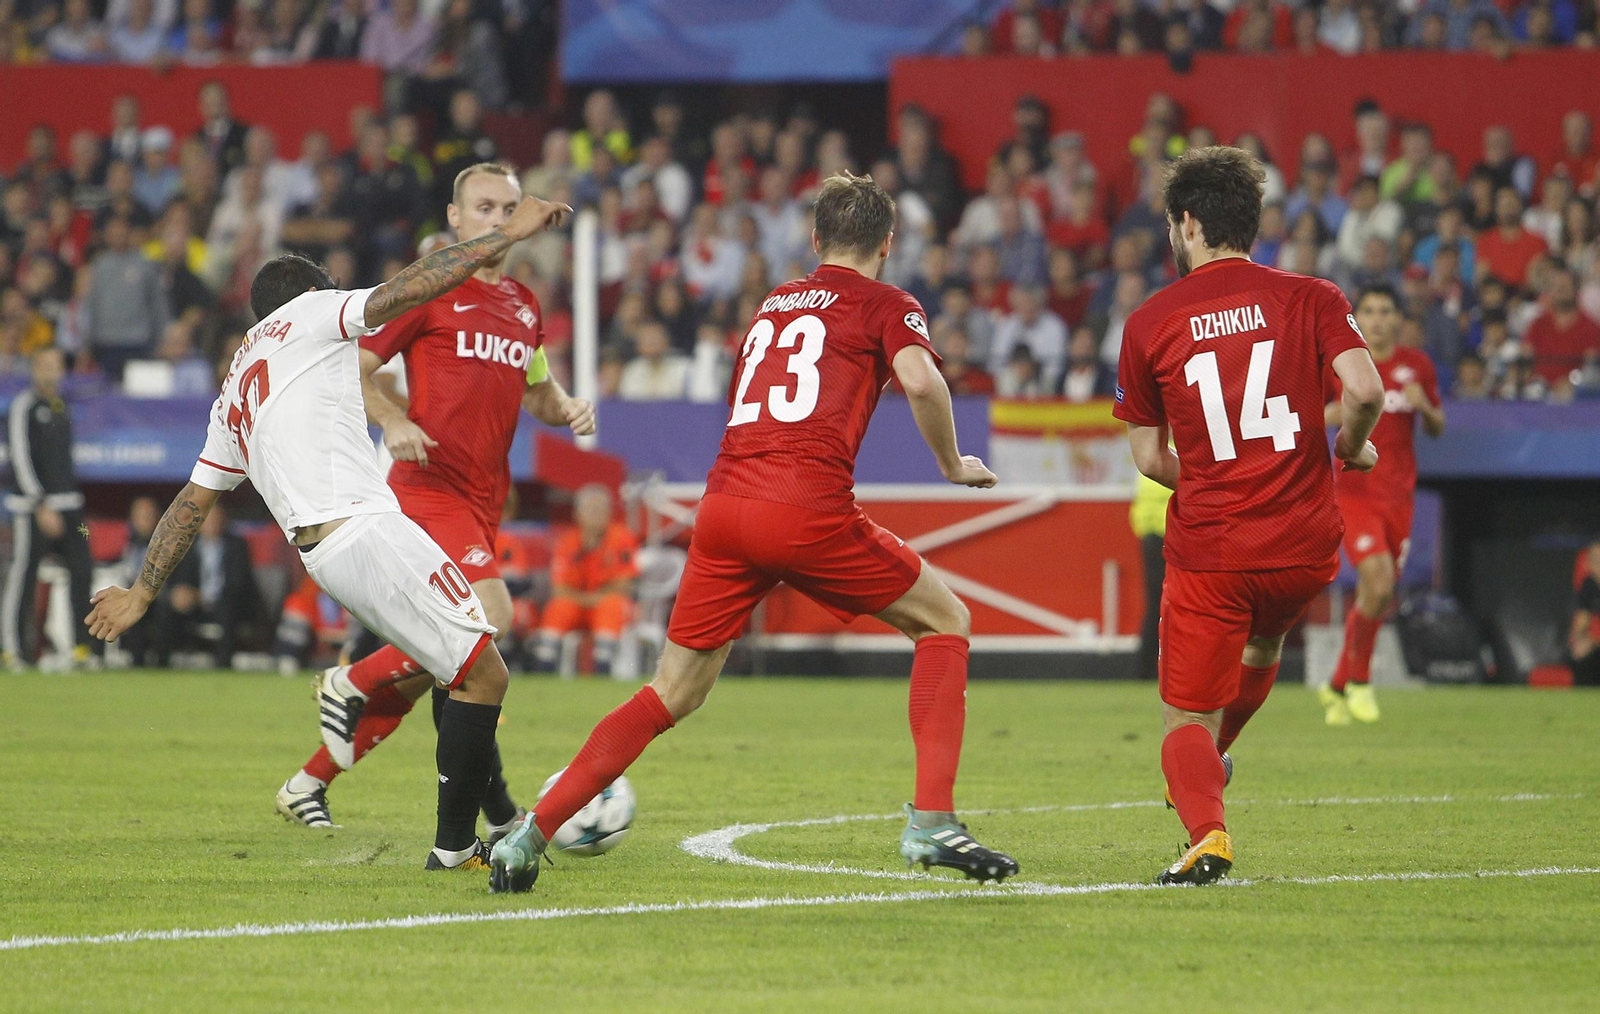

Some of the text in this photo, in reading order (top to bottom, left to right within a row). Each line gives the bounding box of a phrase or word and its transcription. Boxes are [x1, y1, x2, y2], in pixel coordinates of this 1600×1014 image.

[1189, 304, 1268, 342] DZHIKIIA
[726, 314, 827, 427] 23
[1183, 339, 1302, 462] 14
[428, 560, 473, 609] 10
